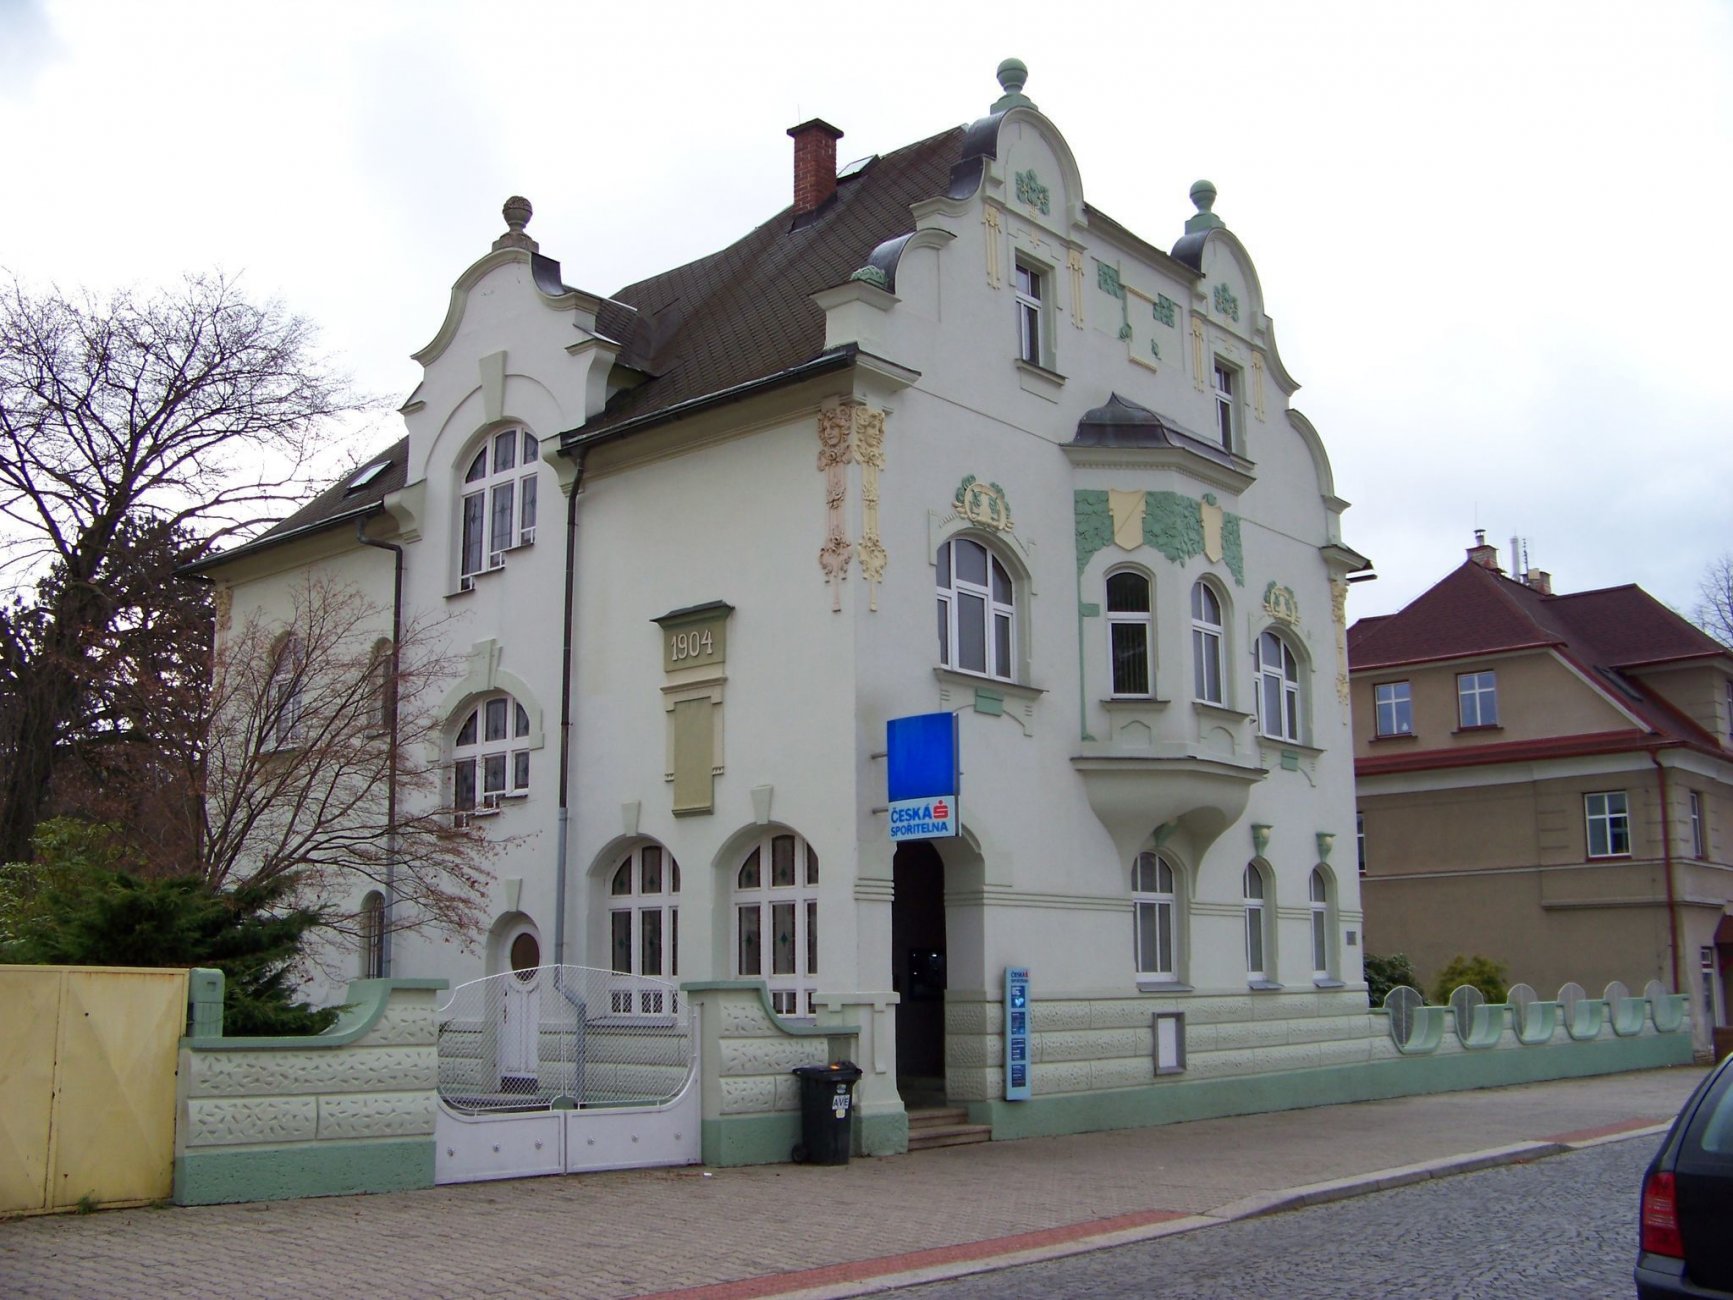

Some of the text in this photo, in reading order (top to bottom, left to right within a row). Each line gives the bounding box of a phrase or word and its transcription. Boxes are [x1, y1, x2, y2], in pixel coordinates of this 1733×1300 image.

[671, 629, 713, 661] 1904
[891, 803, 932, 823] ČESKÁ
[891, 821, 948, 837] SPOŘITELNA
[833, 1096, 849, 1107] AVE
